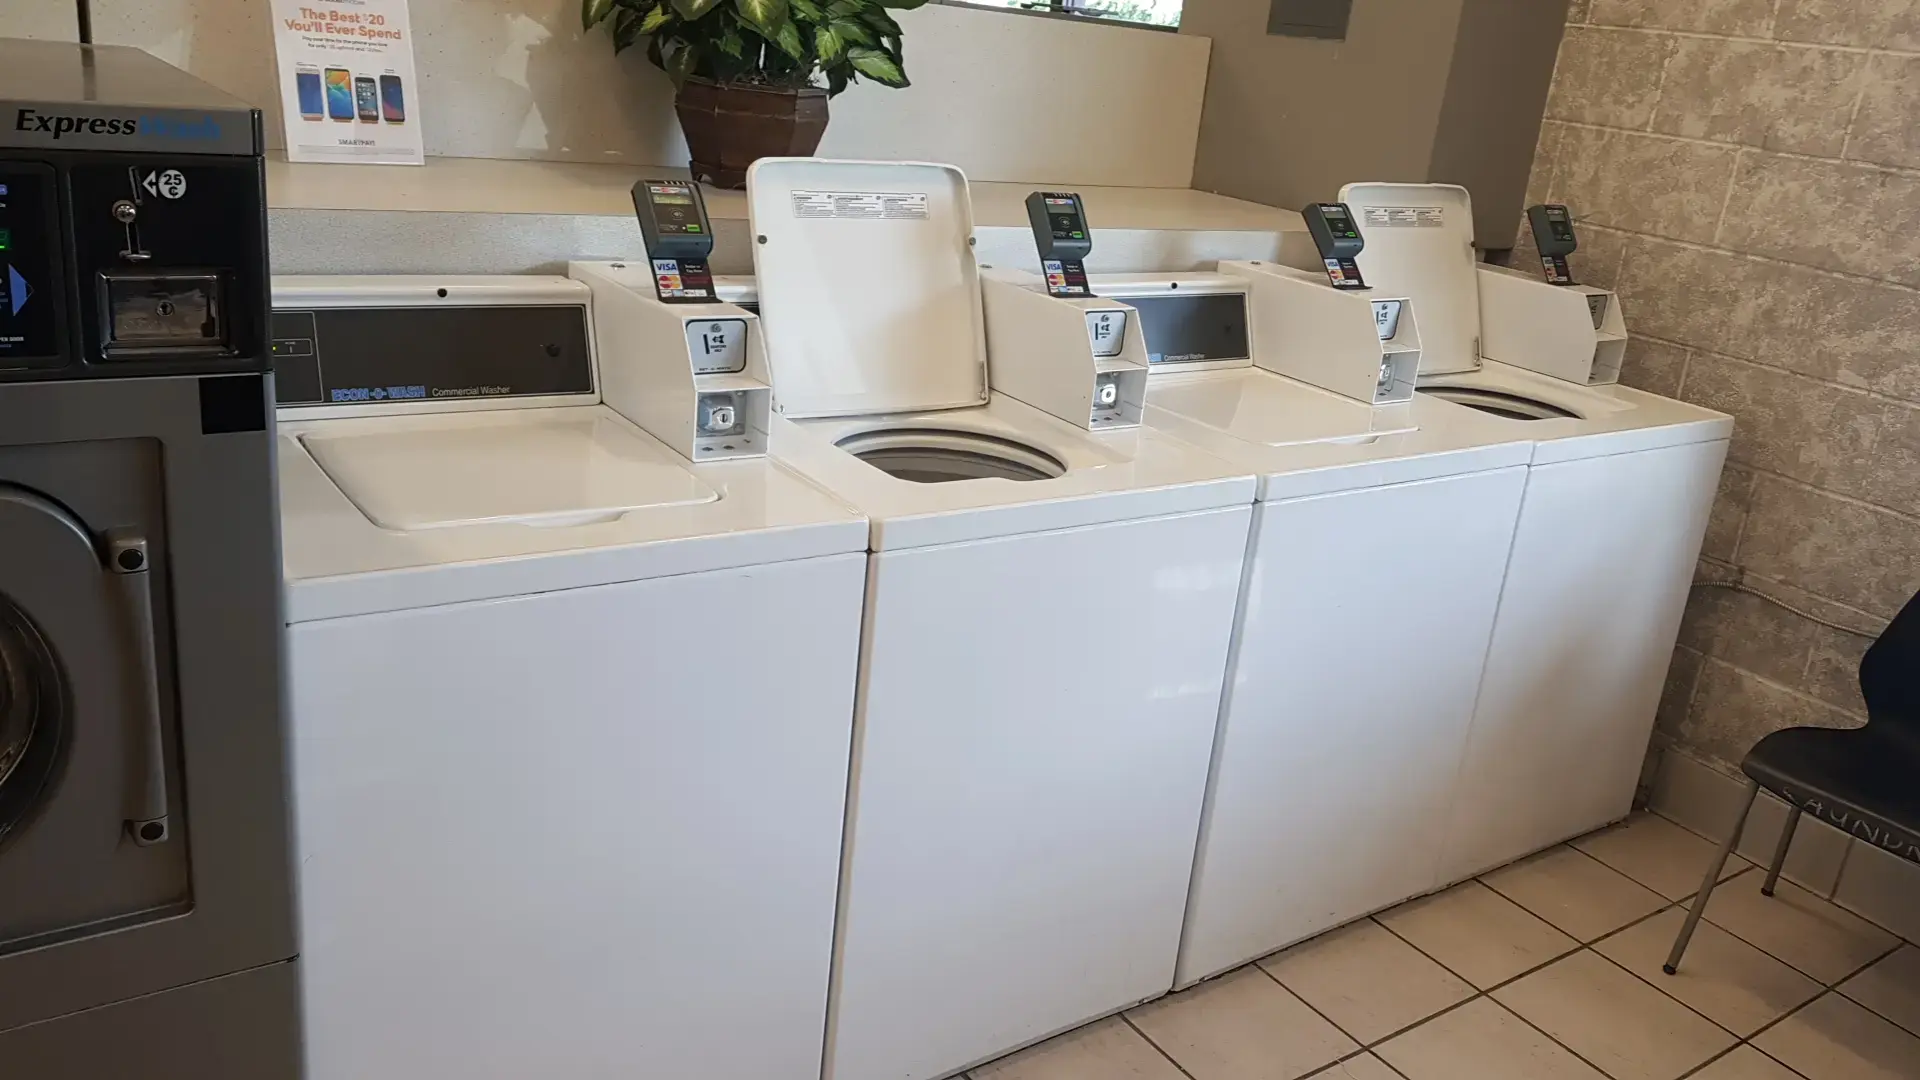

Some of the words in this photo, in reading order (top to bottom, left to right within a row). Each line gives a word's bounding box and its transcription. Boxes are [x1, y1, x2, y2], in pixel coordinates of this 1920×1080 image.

[300, 7, 326, 20] The
[329, 10, 360, 23] Best
[284, 19, 322, 33] You'll
[326, 22, 356, 35] Ever
[359, 25, 402, 39] Spend
[164, 174, 182, 186] 25
[655, 263, 677, 271] VISA
[431, 387, 479, 397] Commercial
[481, 385, 510, 395] Washer
